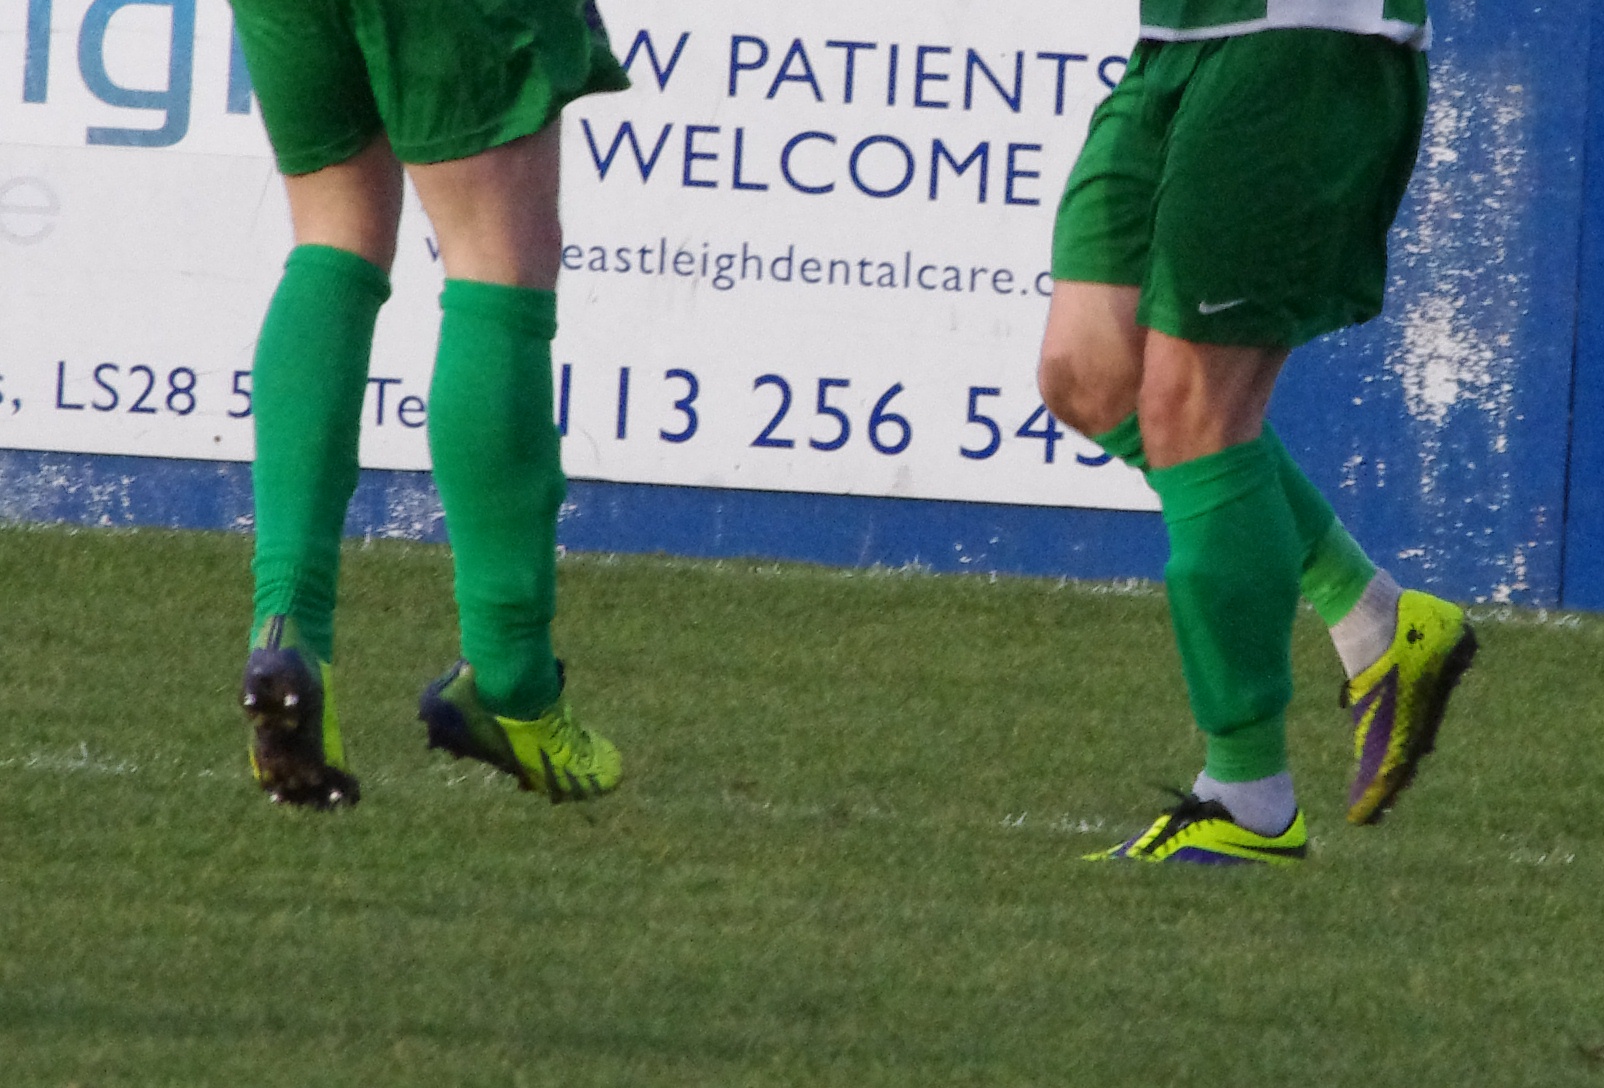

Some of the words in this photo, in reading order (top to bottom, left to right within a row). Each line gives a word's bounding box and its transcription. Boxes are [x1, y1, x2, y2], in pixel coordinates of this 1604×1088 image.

[580, 118, 1042, 206] WELCOME
[56, 361, 197, 416] LS28
[750, 373, 913, 455] 256
[958, 385, 1113, 467] 54
